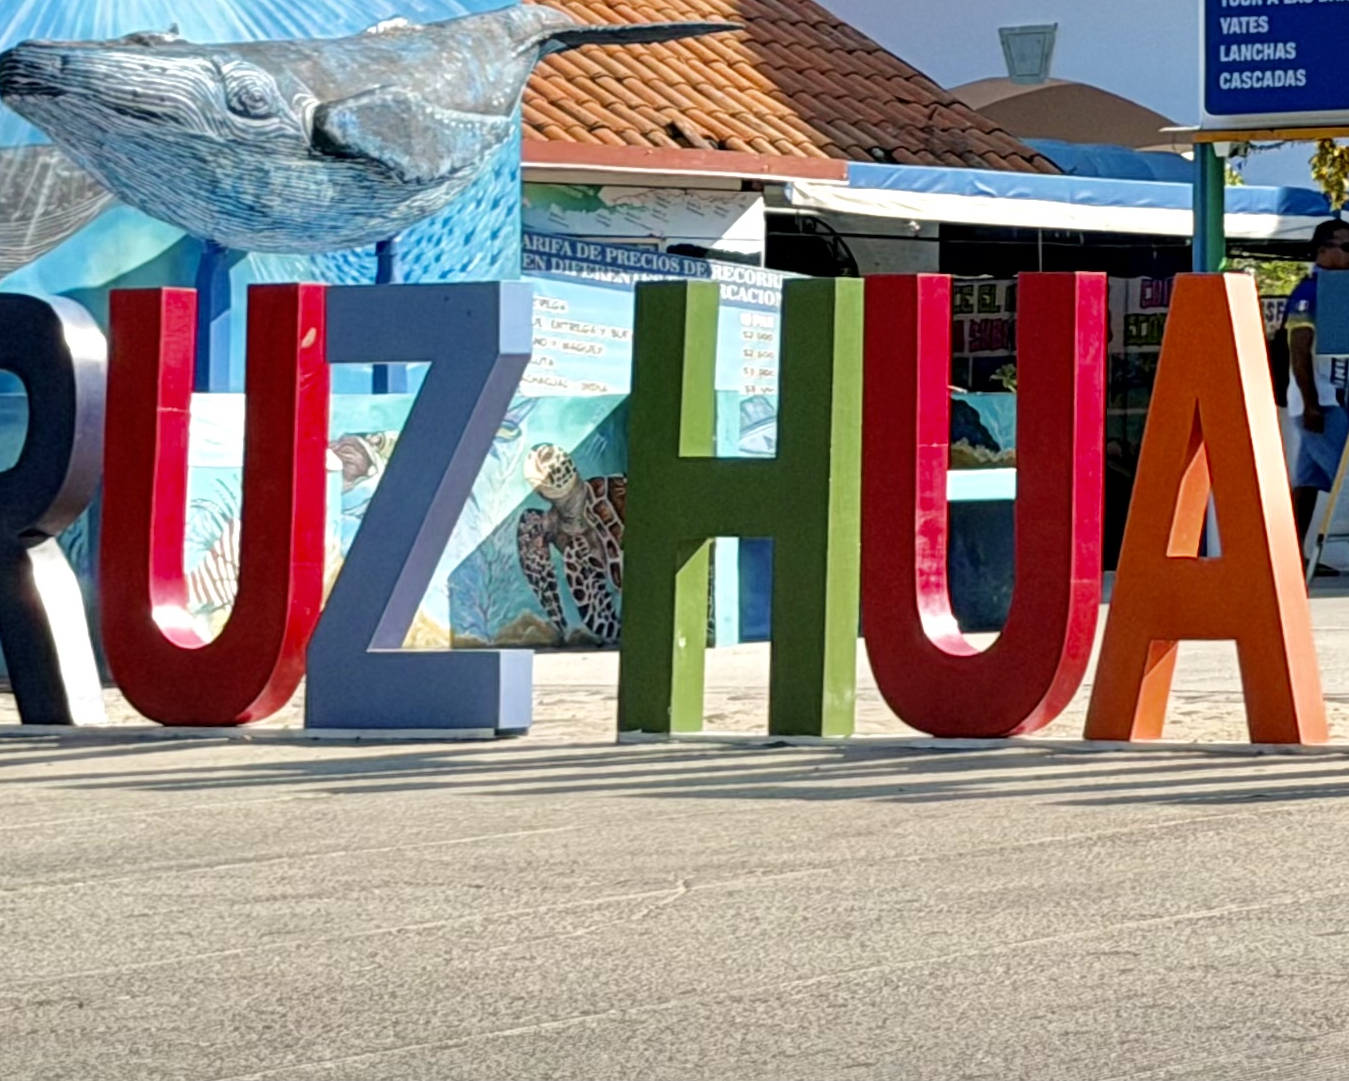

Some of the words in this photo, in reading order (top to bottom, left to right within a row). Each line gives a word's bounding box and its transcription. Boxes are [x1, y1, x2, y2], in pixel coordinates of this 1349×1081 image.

[1219, 15, 1269, 35] YATES
[1219, 42, 1297, 62] LANCHAS
[1219, 69, 1307, 90] CASCADAS
[522, 234, 573, 257] ARIFA
[576, 242, 602, 261] DE
[605, 247, 680, 273] PRECIOS
[683, 259, 709, 280] DE
[522, 252, 548, 270] EN
[551, 257, 651, 285] DIFEREN
